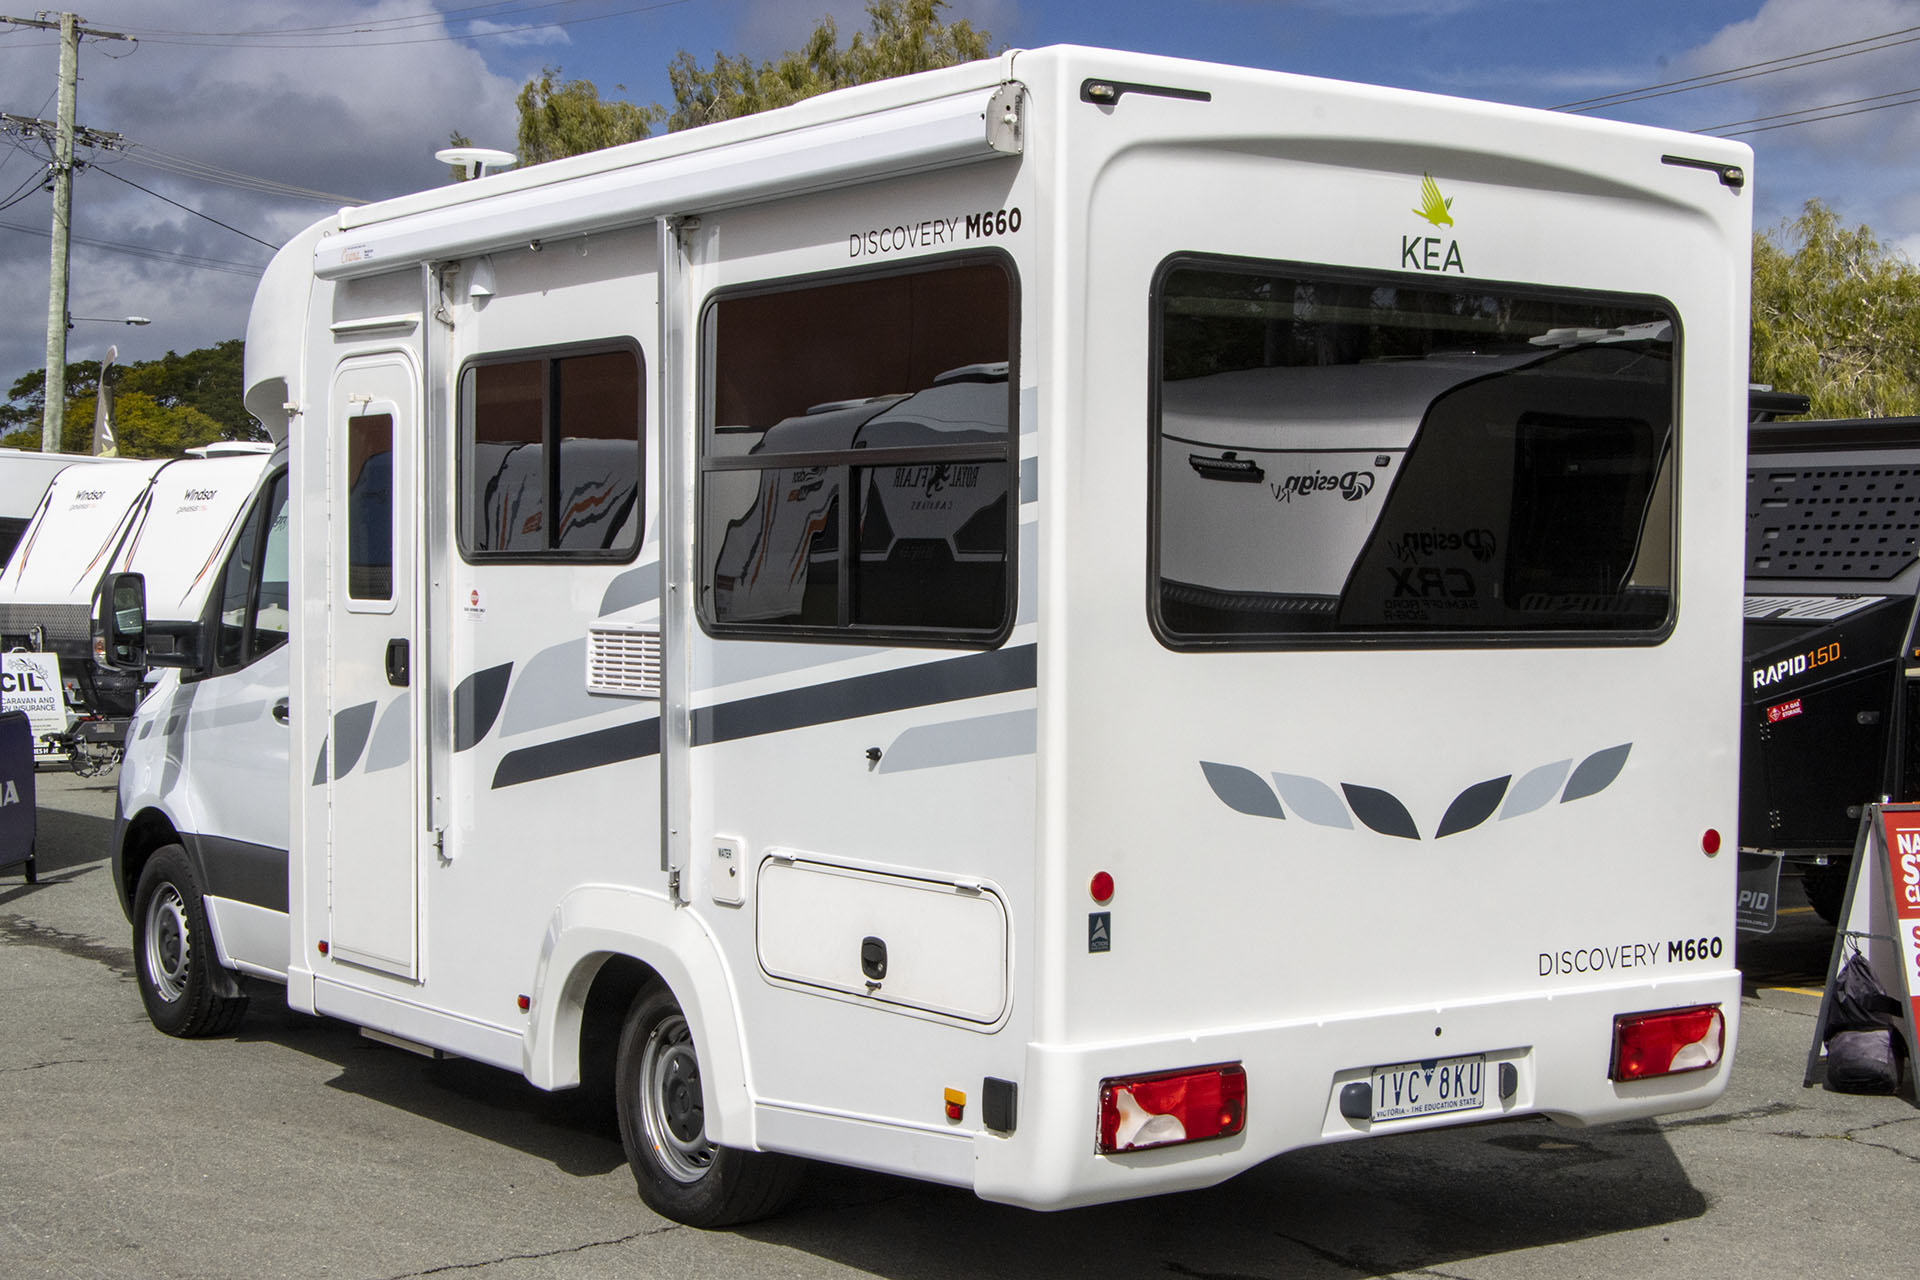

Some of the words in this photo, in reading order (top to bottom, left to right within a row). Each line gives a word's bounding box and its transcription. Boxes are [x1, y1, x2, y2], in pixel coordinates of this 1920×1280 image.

[849, 216, 959, 258] DISCOVERY
[965, 207, 1022, 240] M660
[1401, 235, 1465, 274] KEA
[75, 489, 106, 501] Windsor
[184, 488, 217, 501] Windsor
[0, 672, 43, 692] CIL
[1753, 654, 1806, 689] RAPID
[38, 696, 55, 704] AND
[1539, 942, 1660, 976] DISCOVERY
[1668, 936, 1723, 963] M660
[1379, 1071, 1420, 1108] 1VC
[1439, 1062, 1480, 1099] 8KU
[1376, 1107, 1405, 1118] VICTORIA
[1411, 1105, 1423, 1113] THE
[1424, 1099, 1458, 1112] EDUCATION
[1459, 1097, 1476, 1106] STATE
